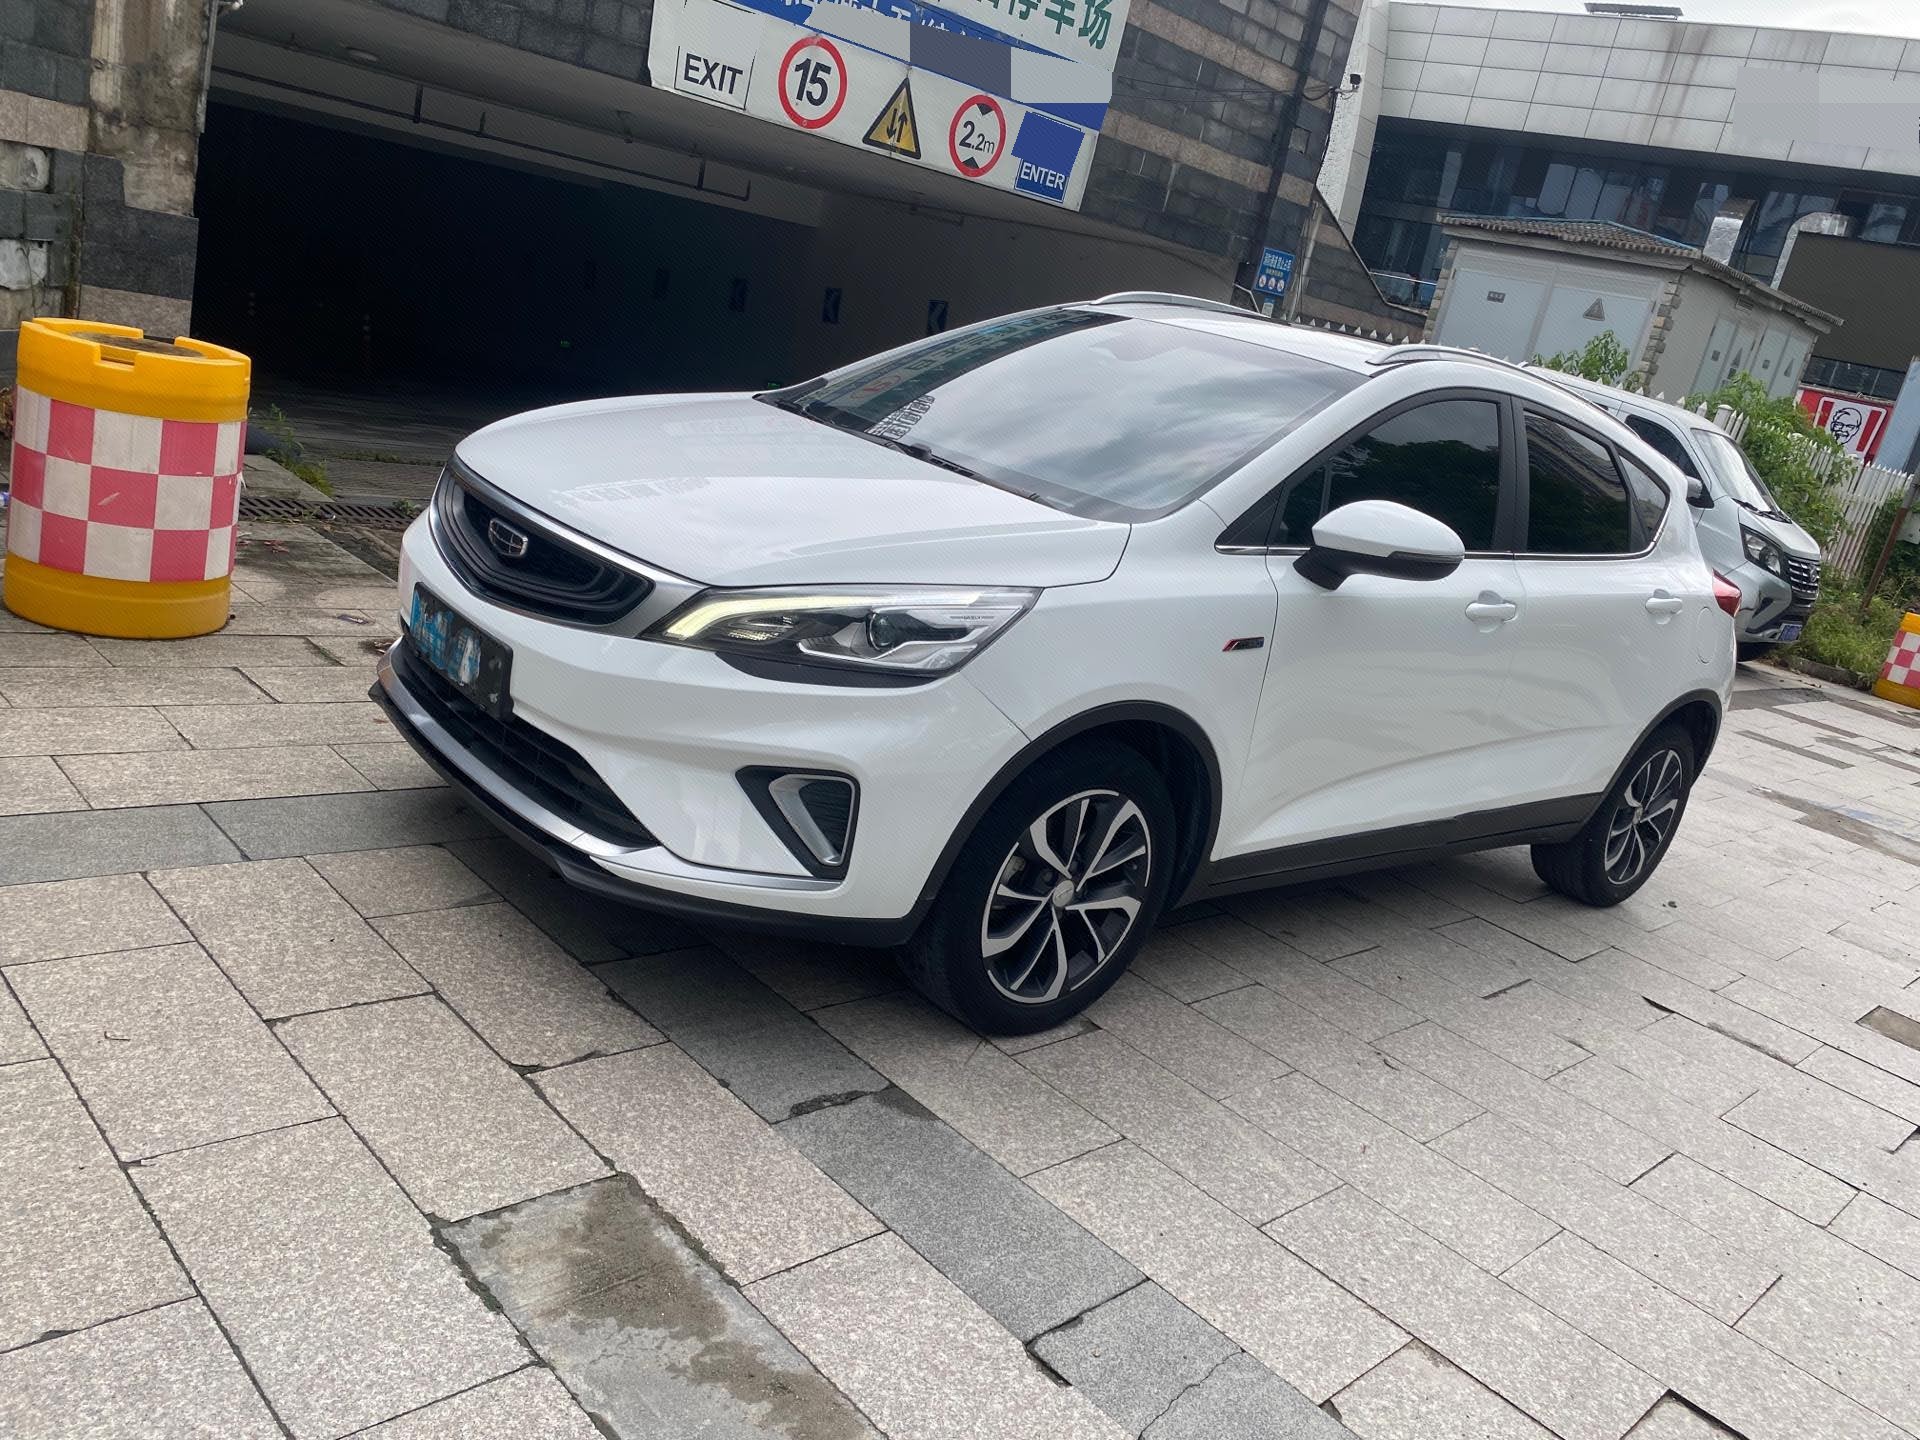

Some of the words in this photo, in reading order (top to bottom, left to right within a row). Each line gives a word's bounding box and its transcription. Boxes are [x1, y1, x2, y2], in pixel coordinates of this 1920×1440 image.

[683, 52, 744, 95] EXIT
[794, 57, 832, 107] 15
[958, 120, 995, 155] 2.2m
[1020, 162, 1066, 191] ENTER
